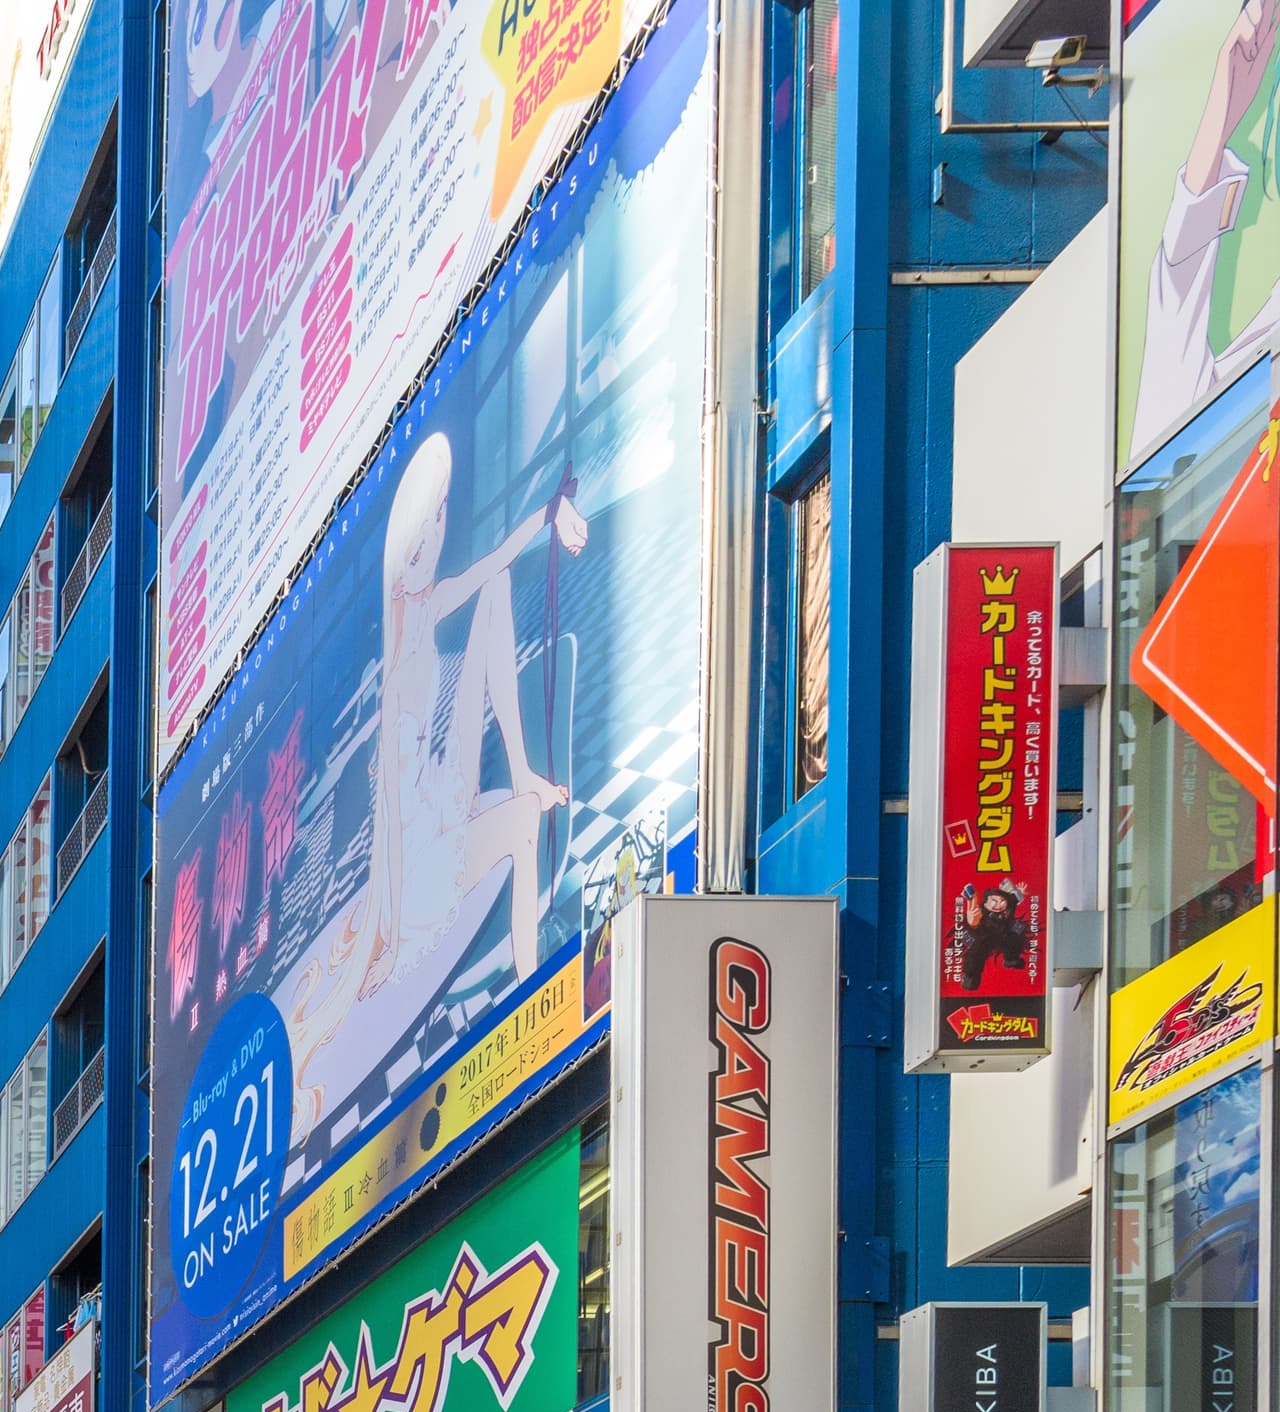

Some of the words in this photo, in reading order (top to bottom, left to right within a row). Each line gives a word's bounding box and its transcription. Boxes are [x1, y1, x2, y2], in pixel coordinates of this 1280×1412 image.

[977, 600, 1018, 875] カードキングダム
[191, 1072, 228, 1121] Blu-ray
[240, 1026, 266, 1063] DVD
[466, 1026, 565, 1118] 全国ロードショー
[960, 1014, 1039, 1041] カードキングダム
[178, 1060, 275, 1240] 12.21
[183, 1247, 217, 1291] ON
[220, 1191, 272, 1261] SALE
